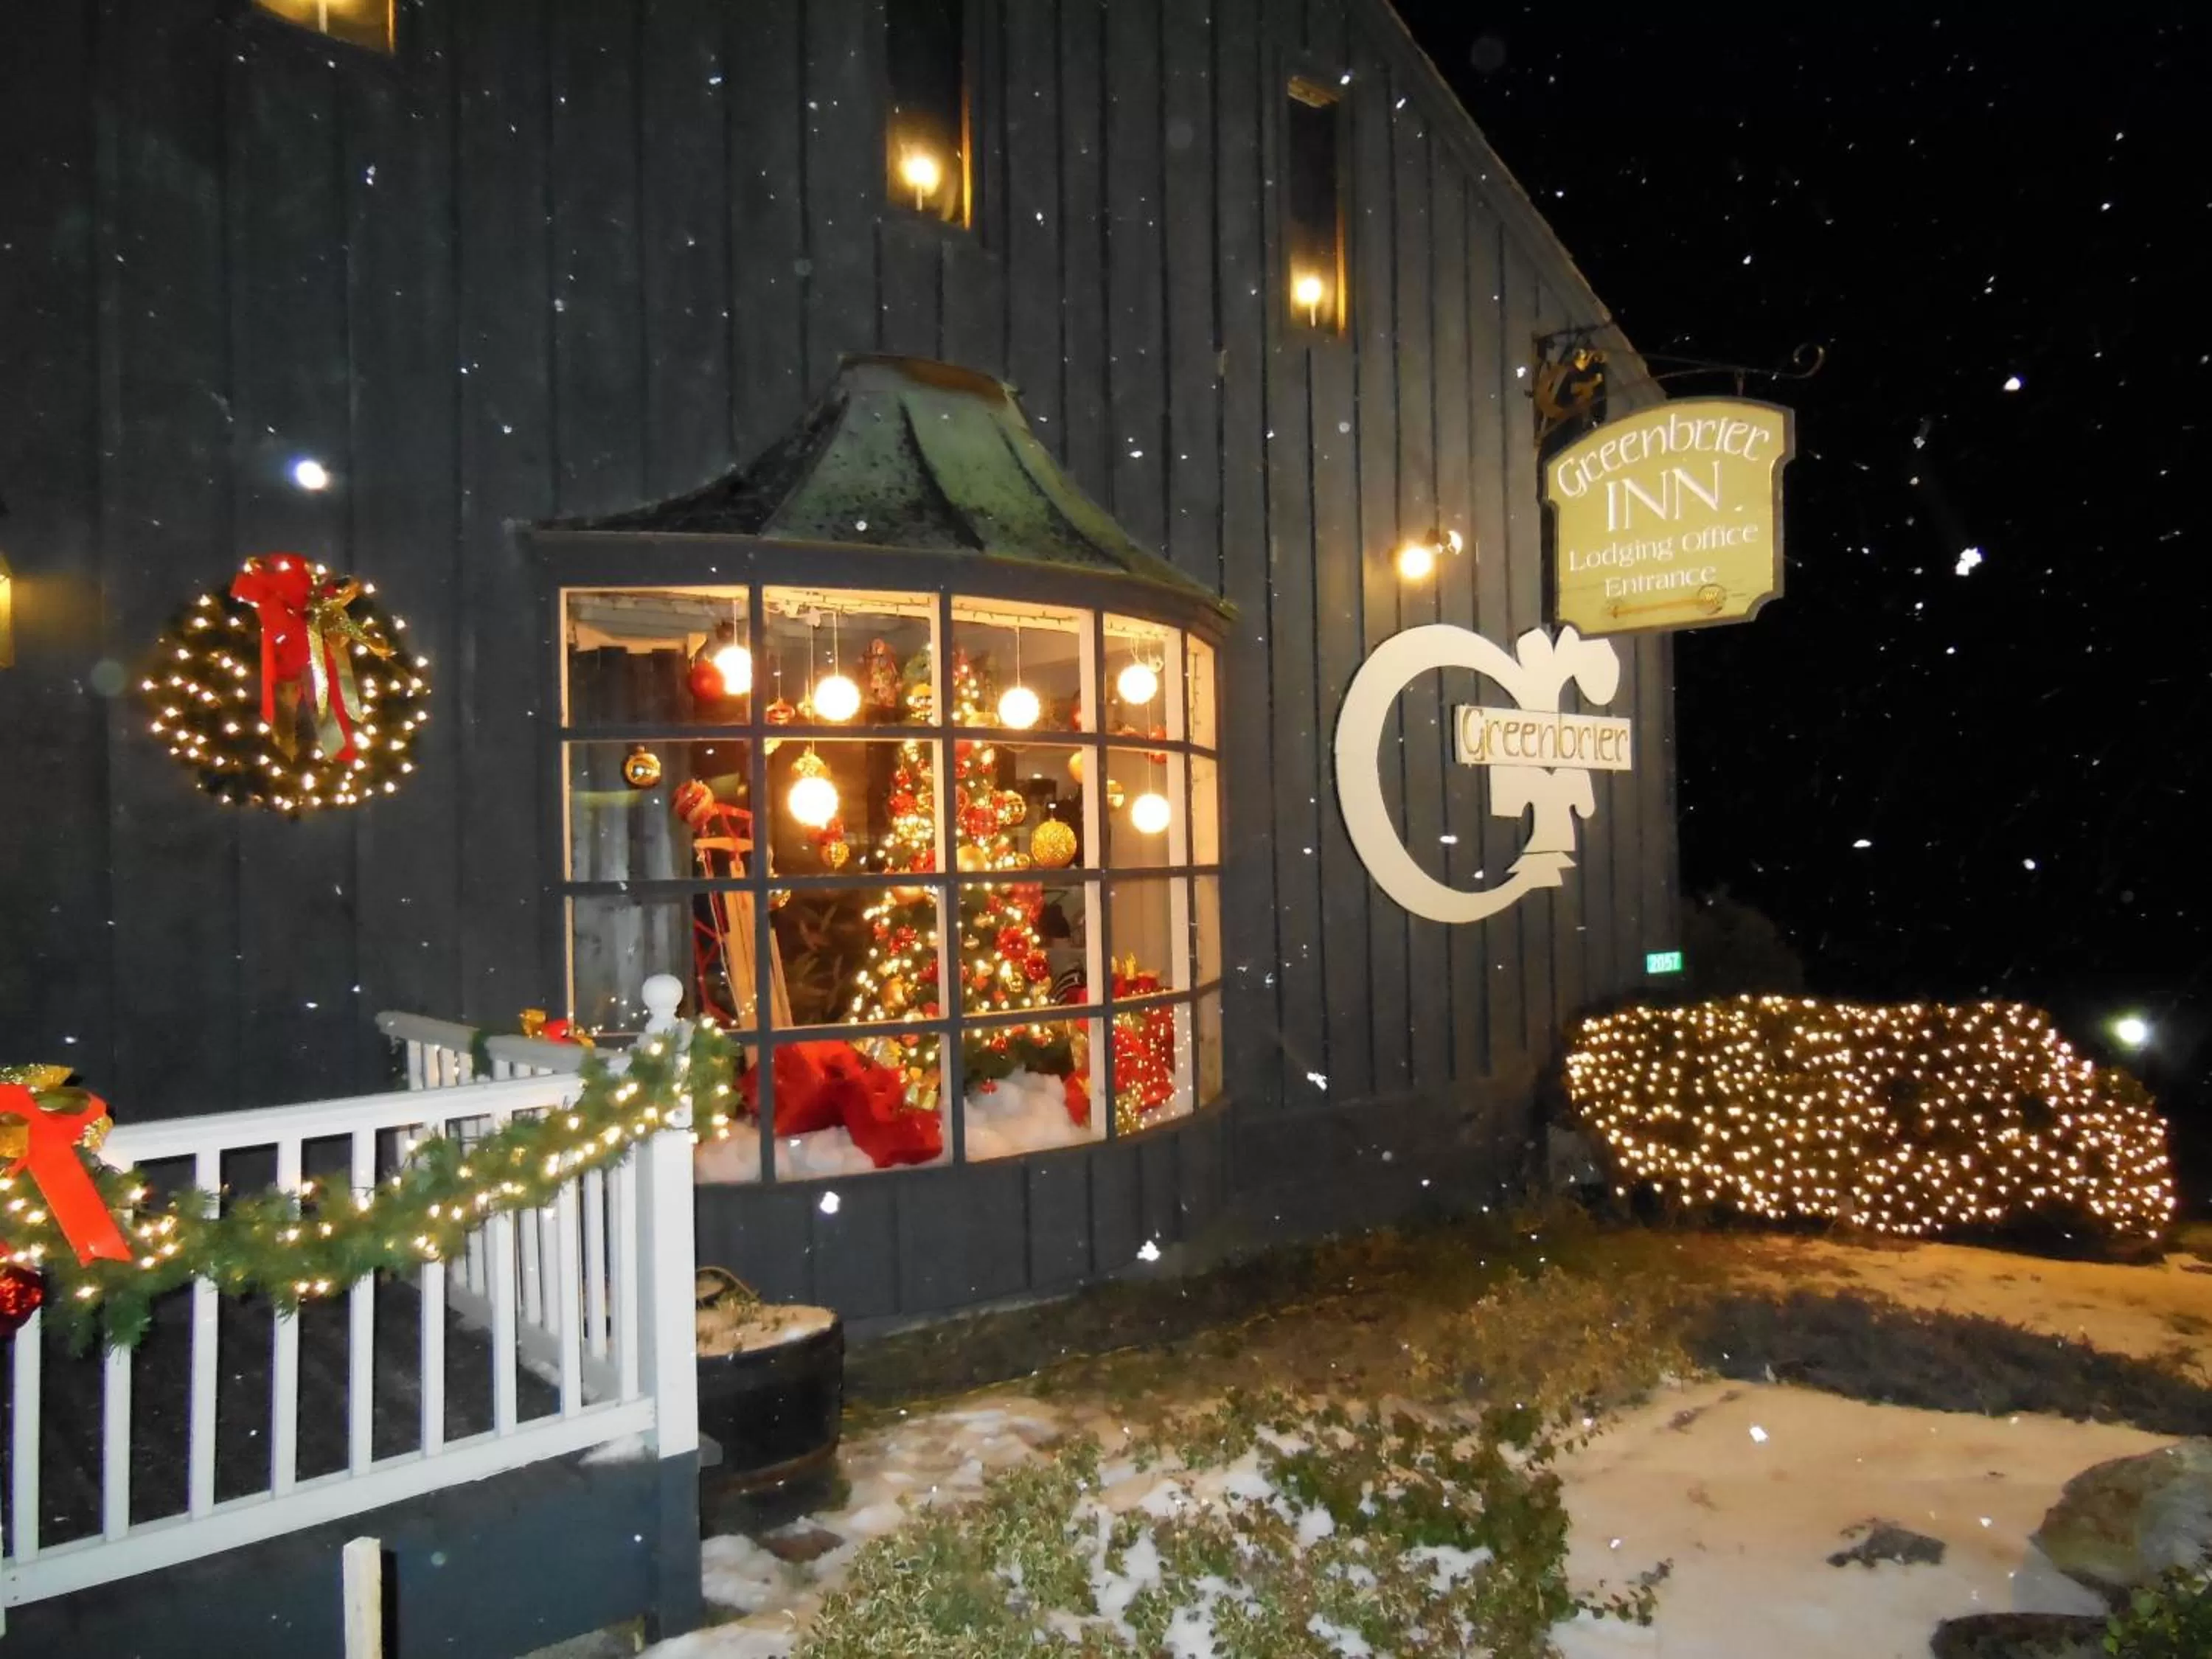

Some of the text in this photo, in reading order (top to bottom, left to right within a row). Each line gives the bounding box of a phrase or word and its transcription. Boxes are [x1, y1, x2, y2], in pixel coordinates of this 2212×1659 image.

[1557, 413, 1770, 498] Greenbrier
[1606, 459, 1720, 532] INN
[1569, 524, 1759, 572] Lodging Office
[1604, 565, 1717, 599] Entrance
[1461, 706, 1629, 762] Greenbrier
